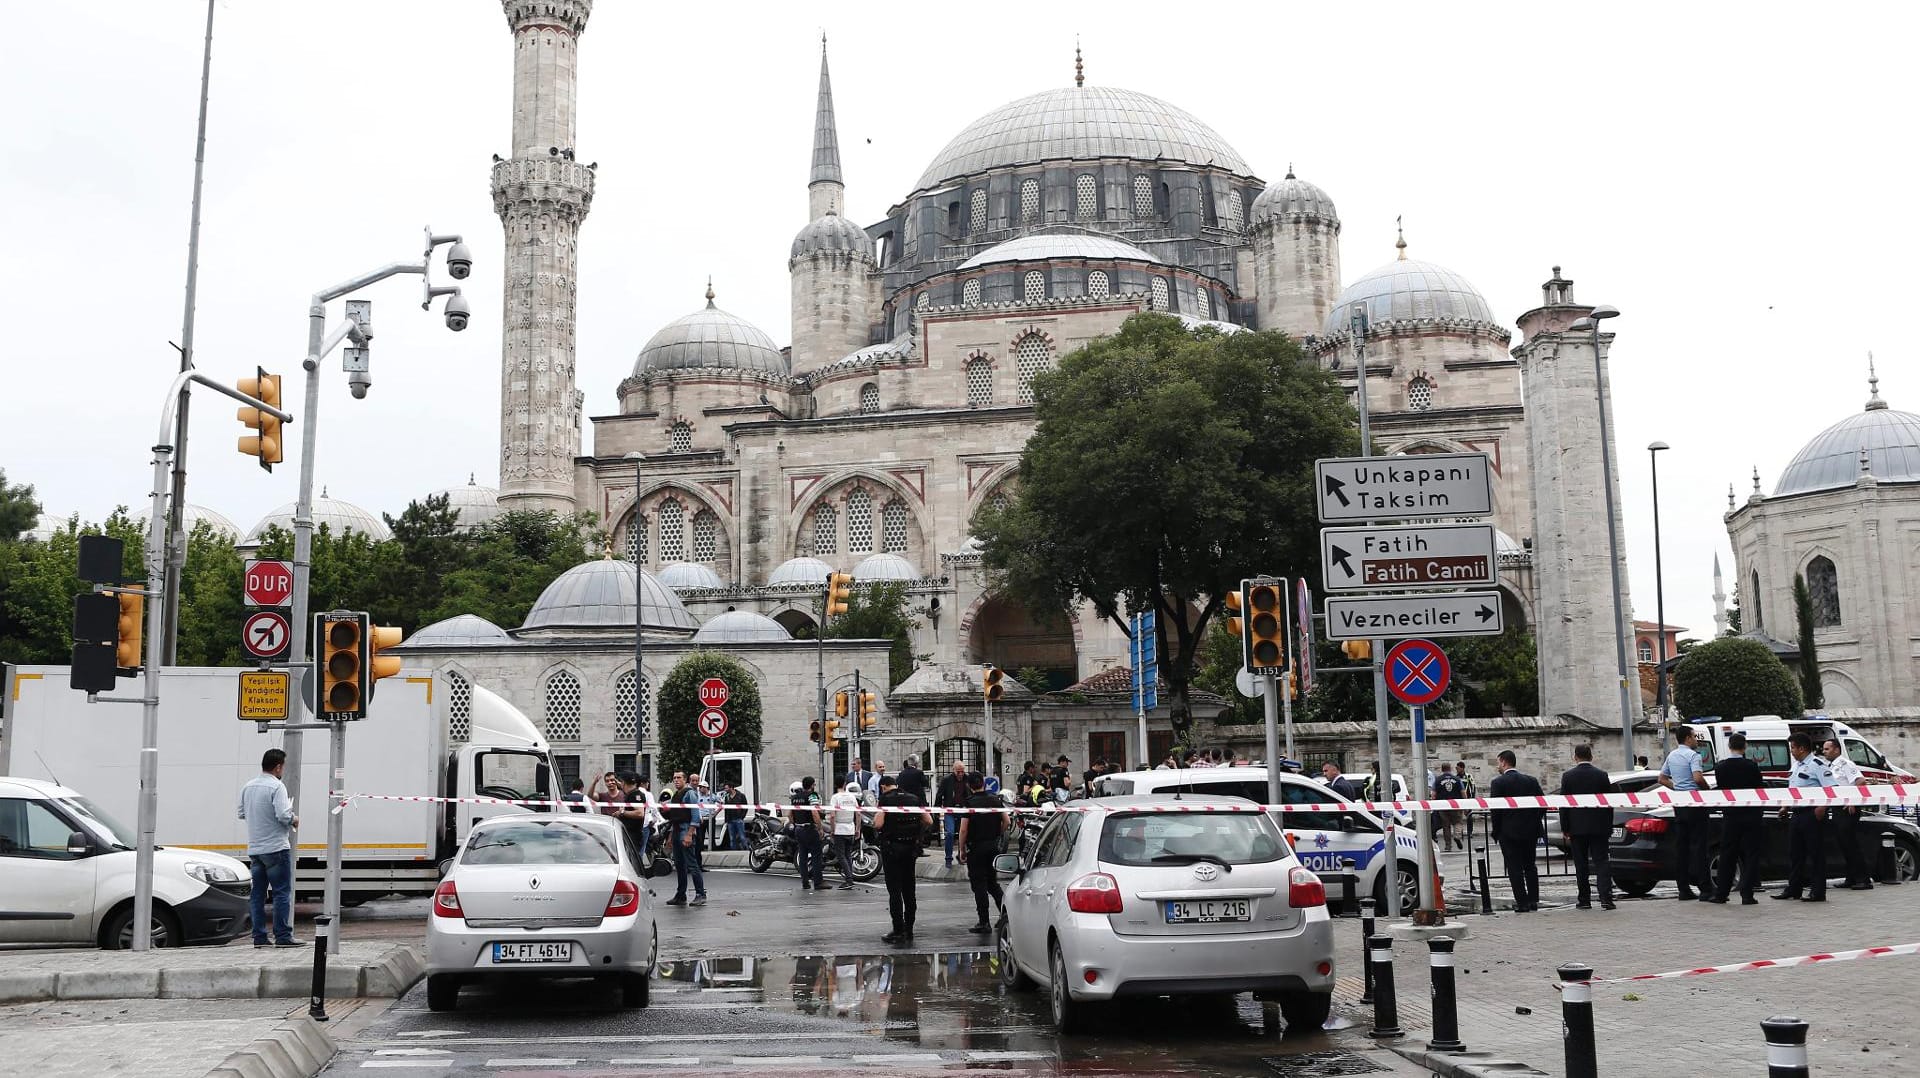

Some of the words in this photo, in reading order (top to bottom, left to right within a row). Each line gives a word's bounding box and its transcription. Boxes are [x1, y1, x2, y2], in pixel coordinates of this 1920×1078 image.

[1354, 466, 1470, 487] Unkapanı
[1357, 491, 1449, 509] Taksim
[1364, 534, 1428, 553] Fatih
[1364, 562, 1418, 582] Fatih
[1426, 561, 1485, 580] Camii
[249, 574, 289, 592] DUR
[1340, 607, 1461, 628] Vezneciler
[1257, 667, 1279, 675] 1151
[248, 696, 279, 704] Klakson
[701, 687, 726, 699] DUR
[329, 712, 354, 721] 1151
[1174, 902, 1190, 918] 34
[1199, 902, 1215, 917] LC
[1223, 902, 1246, 917] 216
[501, 944, 515, 958] 34
[519, 944, 534, 958] FT
[539, 944, 568, 958] 4614
